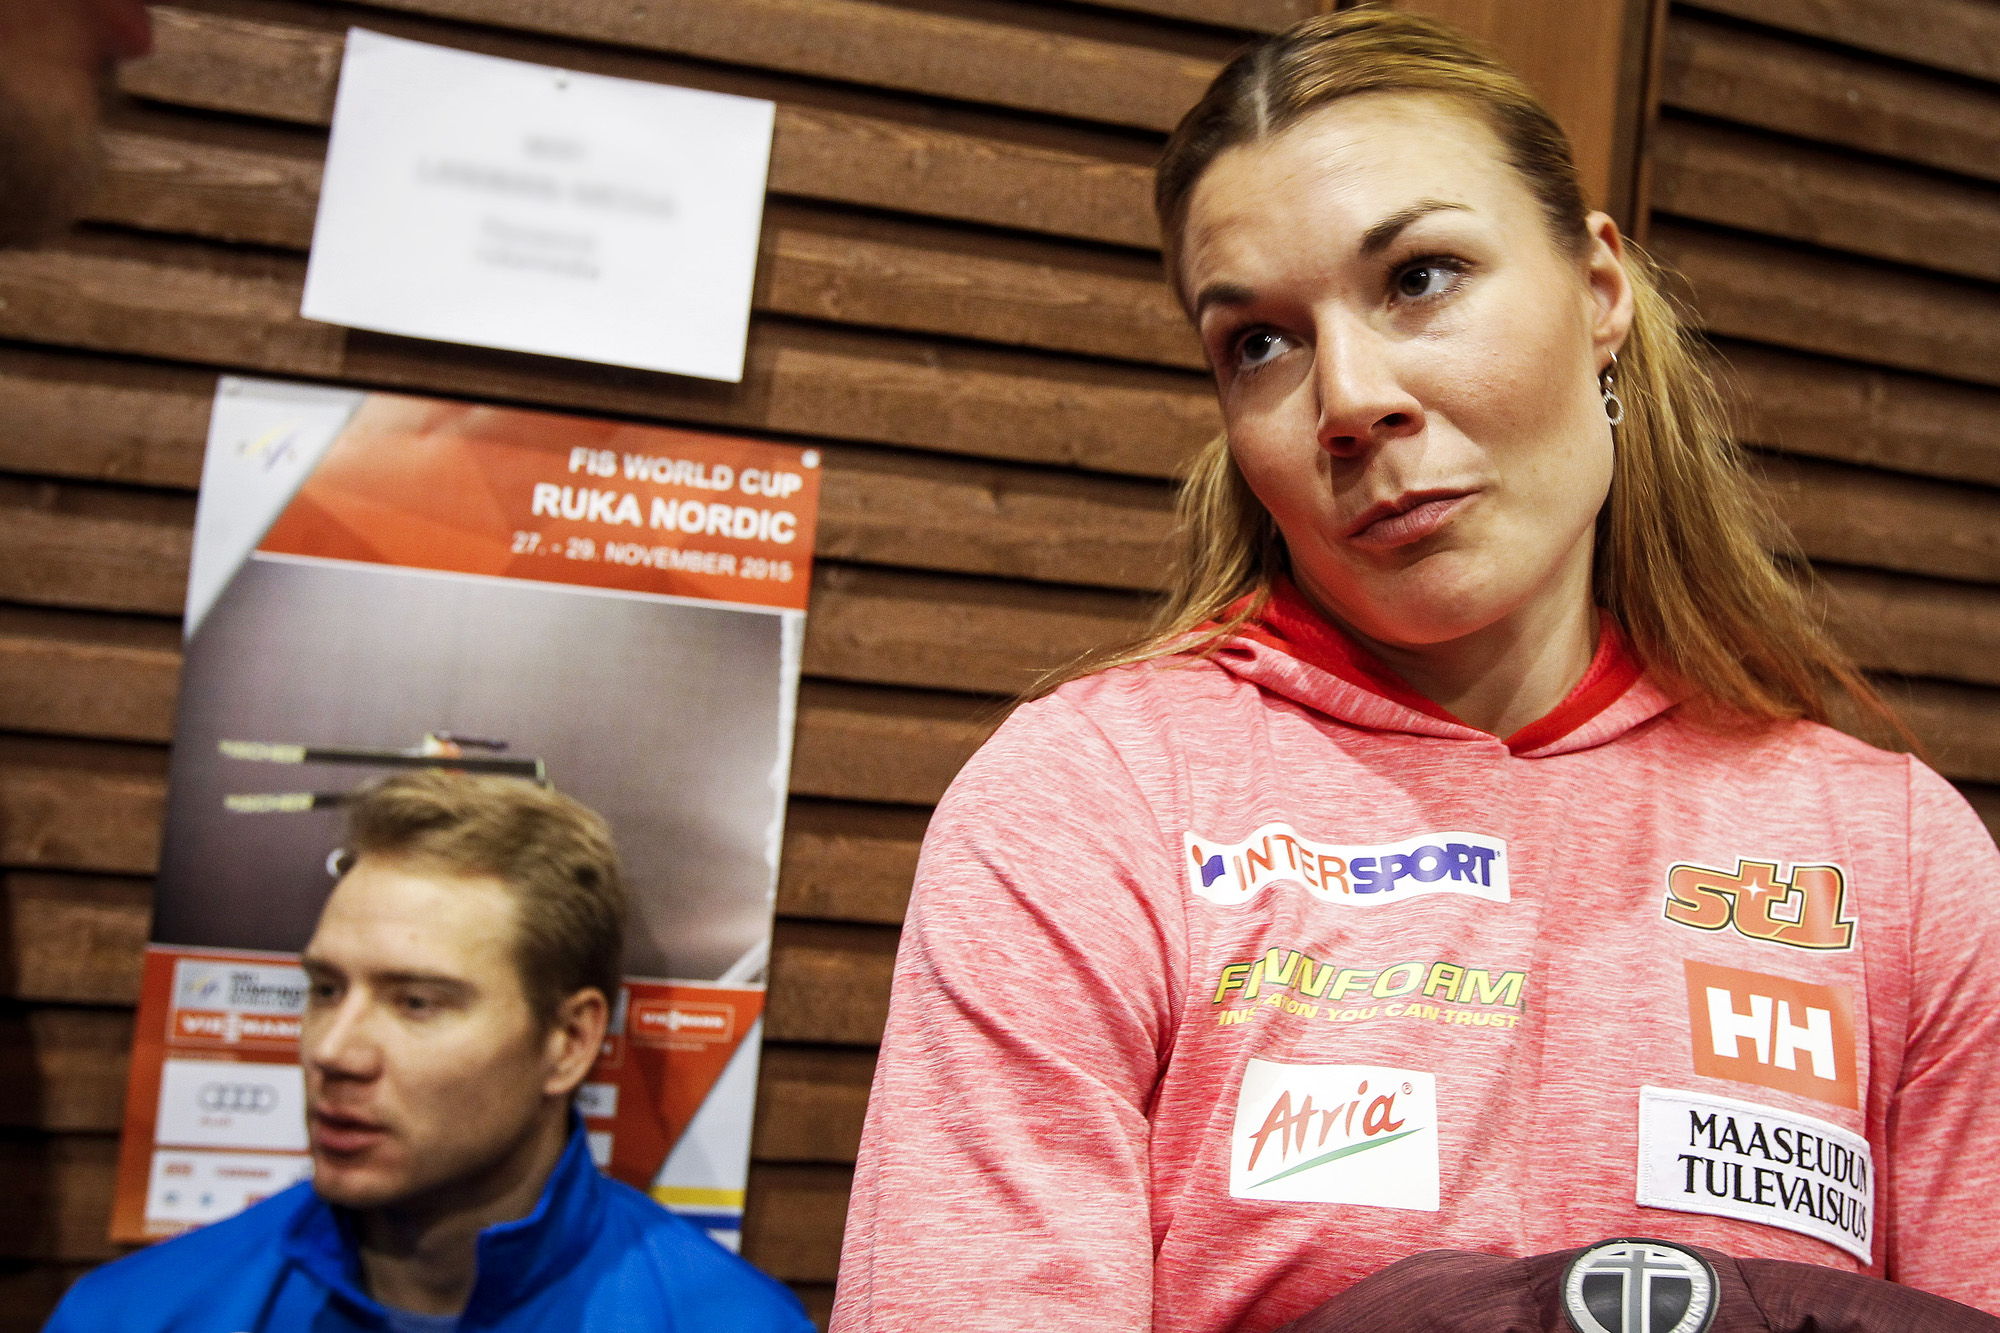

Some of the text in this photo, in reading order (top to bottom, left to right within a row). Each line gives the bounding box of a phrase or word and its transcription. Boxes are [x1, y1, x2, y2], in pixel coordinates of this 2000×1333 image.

[568, 446, 803, 497] FIS WORLD CUP
[532, 483, 797, 544] RUKA NORDIC
[604, 541, 737, 577] NOVEMBER
[739, 556, 793, 582] 2015
[1233, 834, 1496, 895] INTERSPORT
[1213, 947, 1526, 1006] FINNFOAM
[1327, 1005, 1380, 1022] YOU
[1384, 1003, 1440, 1021] CAN
[1444, 1009, 1520, 1029] TRUST
[1706, 986, 1837, 1081] HH
[1247, 1080, 1406, 1172] Atria
[1689, 1110, 1867, 1196] MAASEUDUN
[1677, 1153, 1867, 1242] TULEVAISUUS
